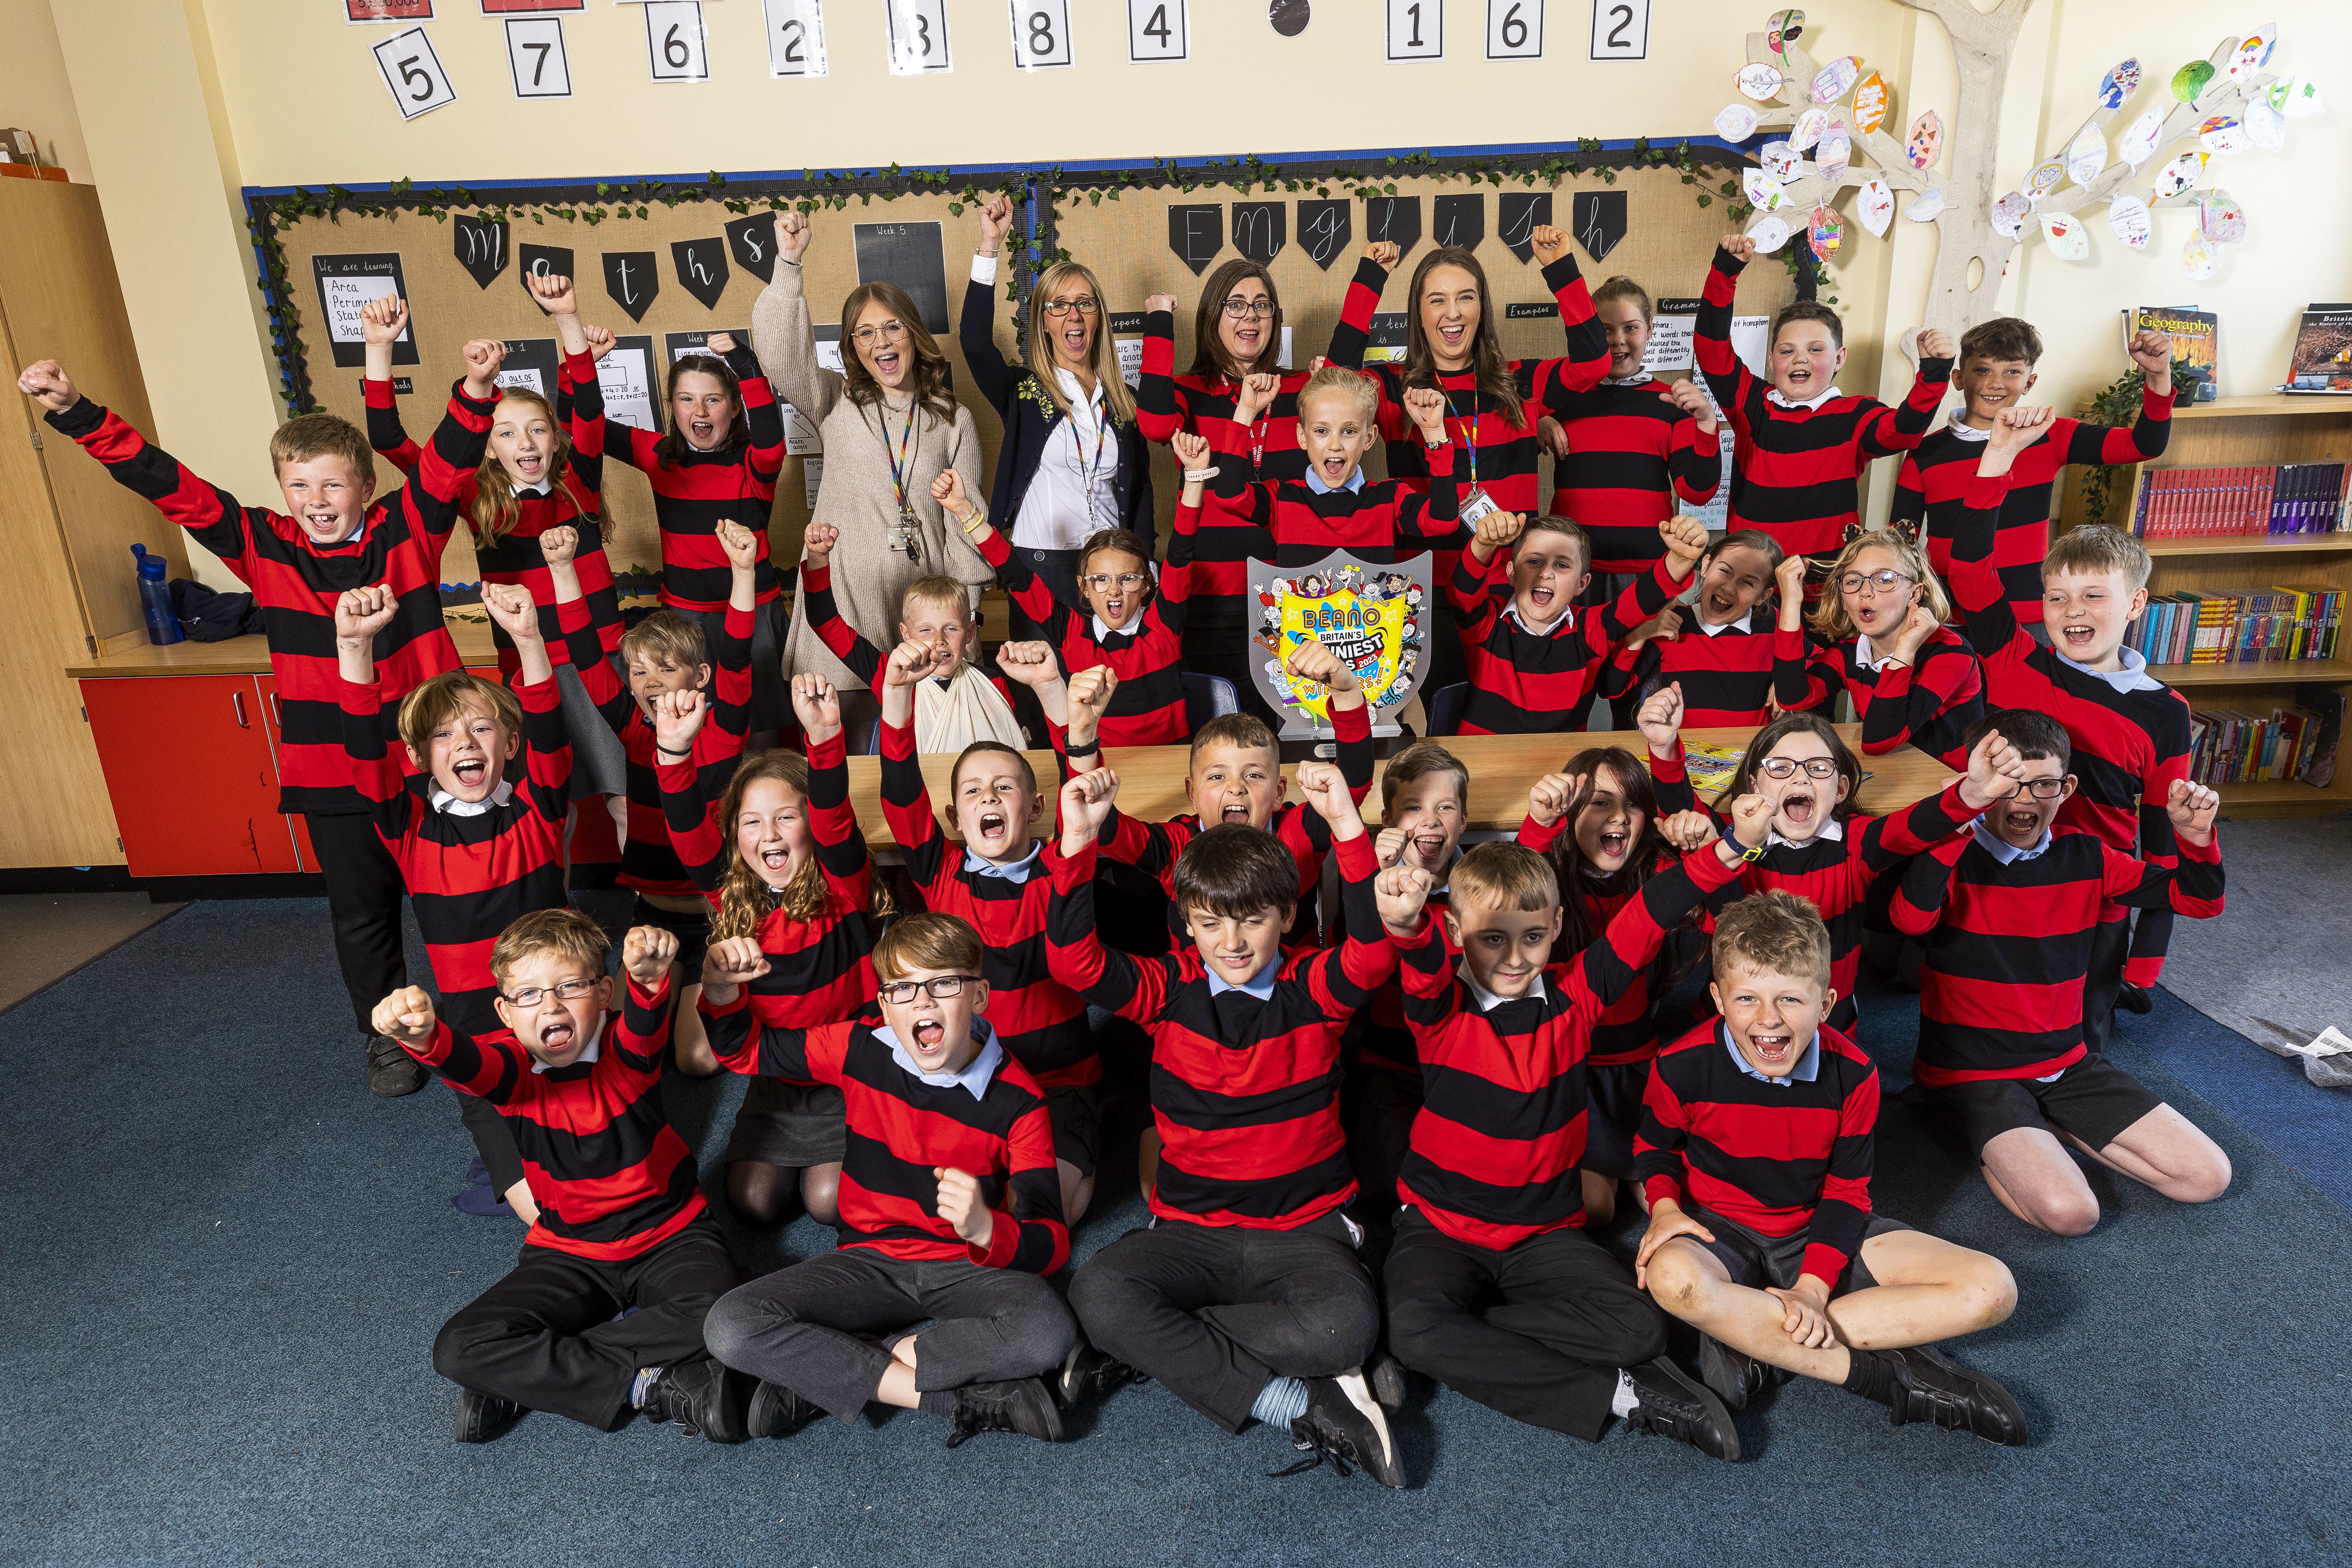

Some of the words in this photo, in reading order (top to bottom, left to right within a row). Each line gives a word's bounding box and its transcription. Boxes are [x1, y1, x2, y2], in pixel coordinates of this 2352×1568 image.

[876, 225, 895, 234] Week
[900, 225, 906, 235] 5
[317, 259, 332, 272] We
[342, 263, 358, 271] are
[332, 280, 359, 292] Area
[333, 295, 378, 308] Perimet
[1662, 299, 1700, 310] Gramm
[1510, 305, 1549, 317] Examples
[1386, 317, 1408, 329] text
[2140, 315, 2215, 335] Geography
[687, 333, 704, 342] Week
[506, 343, 514, 353] ek
[519, 342, 526, 351] 1
[1133, 343, 1142, 351] th
[1659, 347, 1690, 357] differently
[1122, 363, 1141, 371] throu
[509, 374, 523, 382] out
[524, 374, 532, 382] of
[1125, 371, 1141, 381] writ
[1304, 608, 1381, 628] BEANO
[1321, 631, 1361, 641] BRITAIN'S
[1358, 654, 1378, 668] 2023
